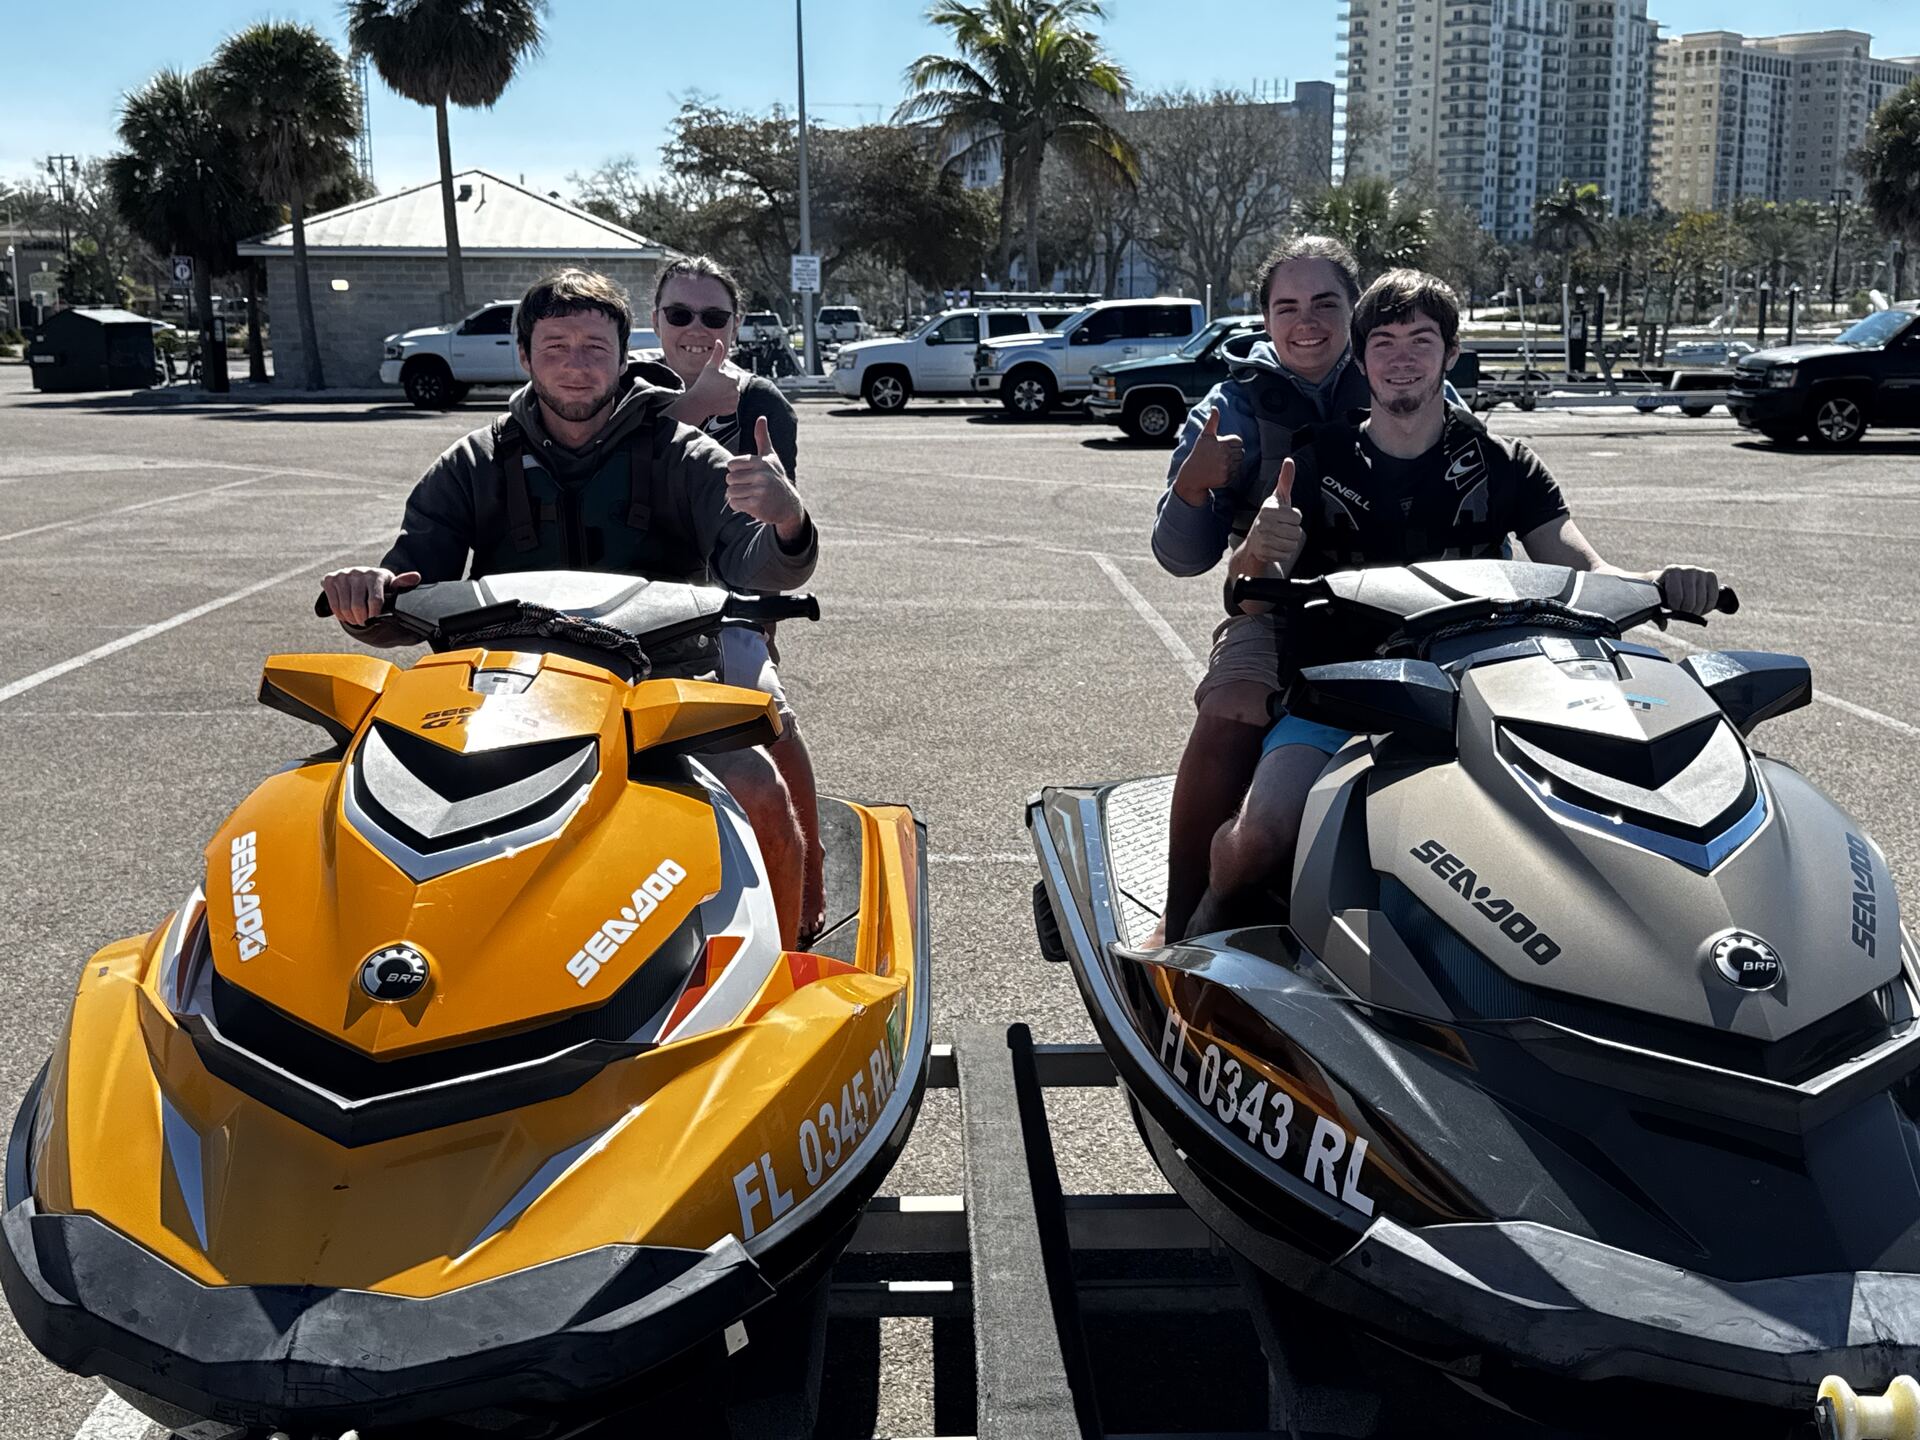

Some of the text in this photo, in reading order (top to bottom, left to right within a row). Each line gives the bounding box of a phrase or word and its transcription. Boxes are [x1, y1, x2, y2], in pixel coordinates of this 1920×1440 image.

[386, 972, 423, 984] BRP
[1742, 961, 1777, 972] BRP
[733, 1151, 794, 1241] FL
[798, 1070, 869, 1187] 0345
[1159, 1006, 1375, 1217] FL 0343 RL
